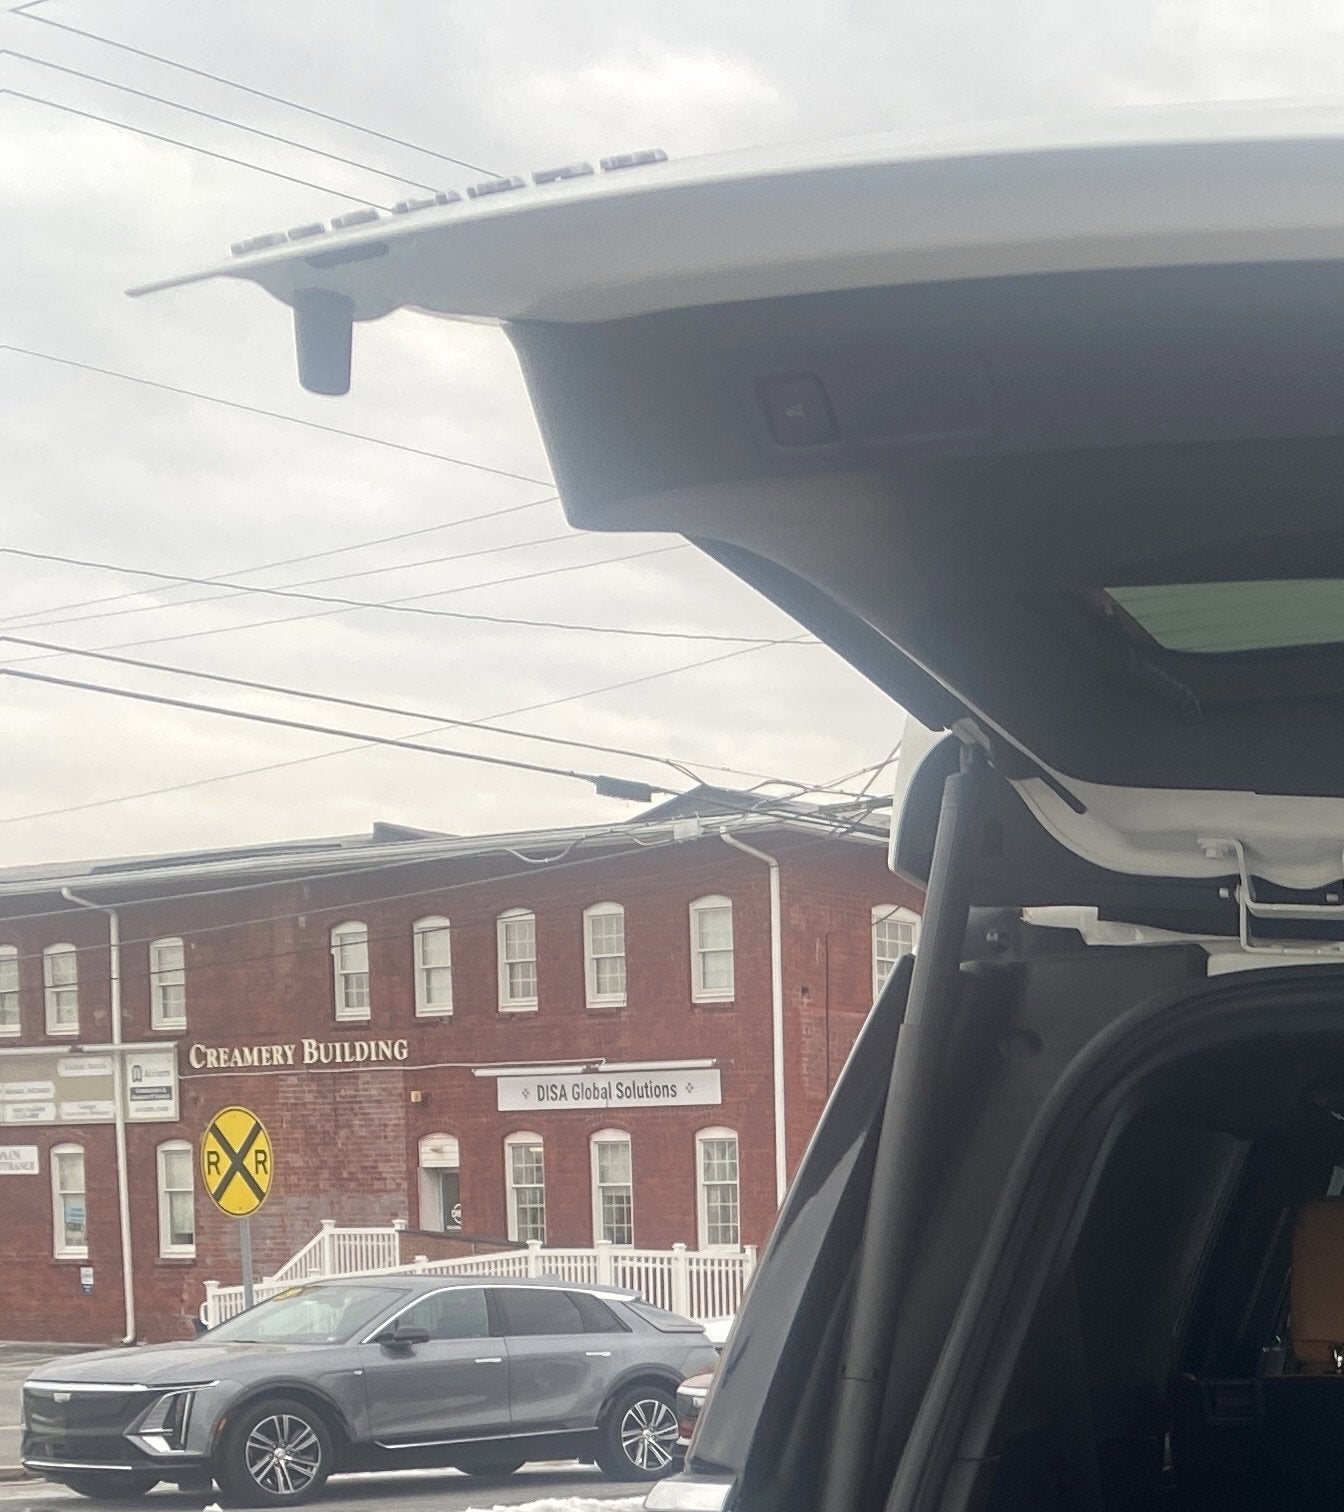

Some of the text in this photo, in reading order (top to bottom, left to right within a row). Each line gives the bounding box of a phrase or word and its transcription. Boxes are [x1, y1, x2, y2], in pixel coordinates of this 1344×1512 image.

[189, 1039, 408, 1069] CREAMERY BUILDING
[536, 1080, 677, 1102] DISA Global Solutions
[207, 1150, 268, 1175] R R
